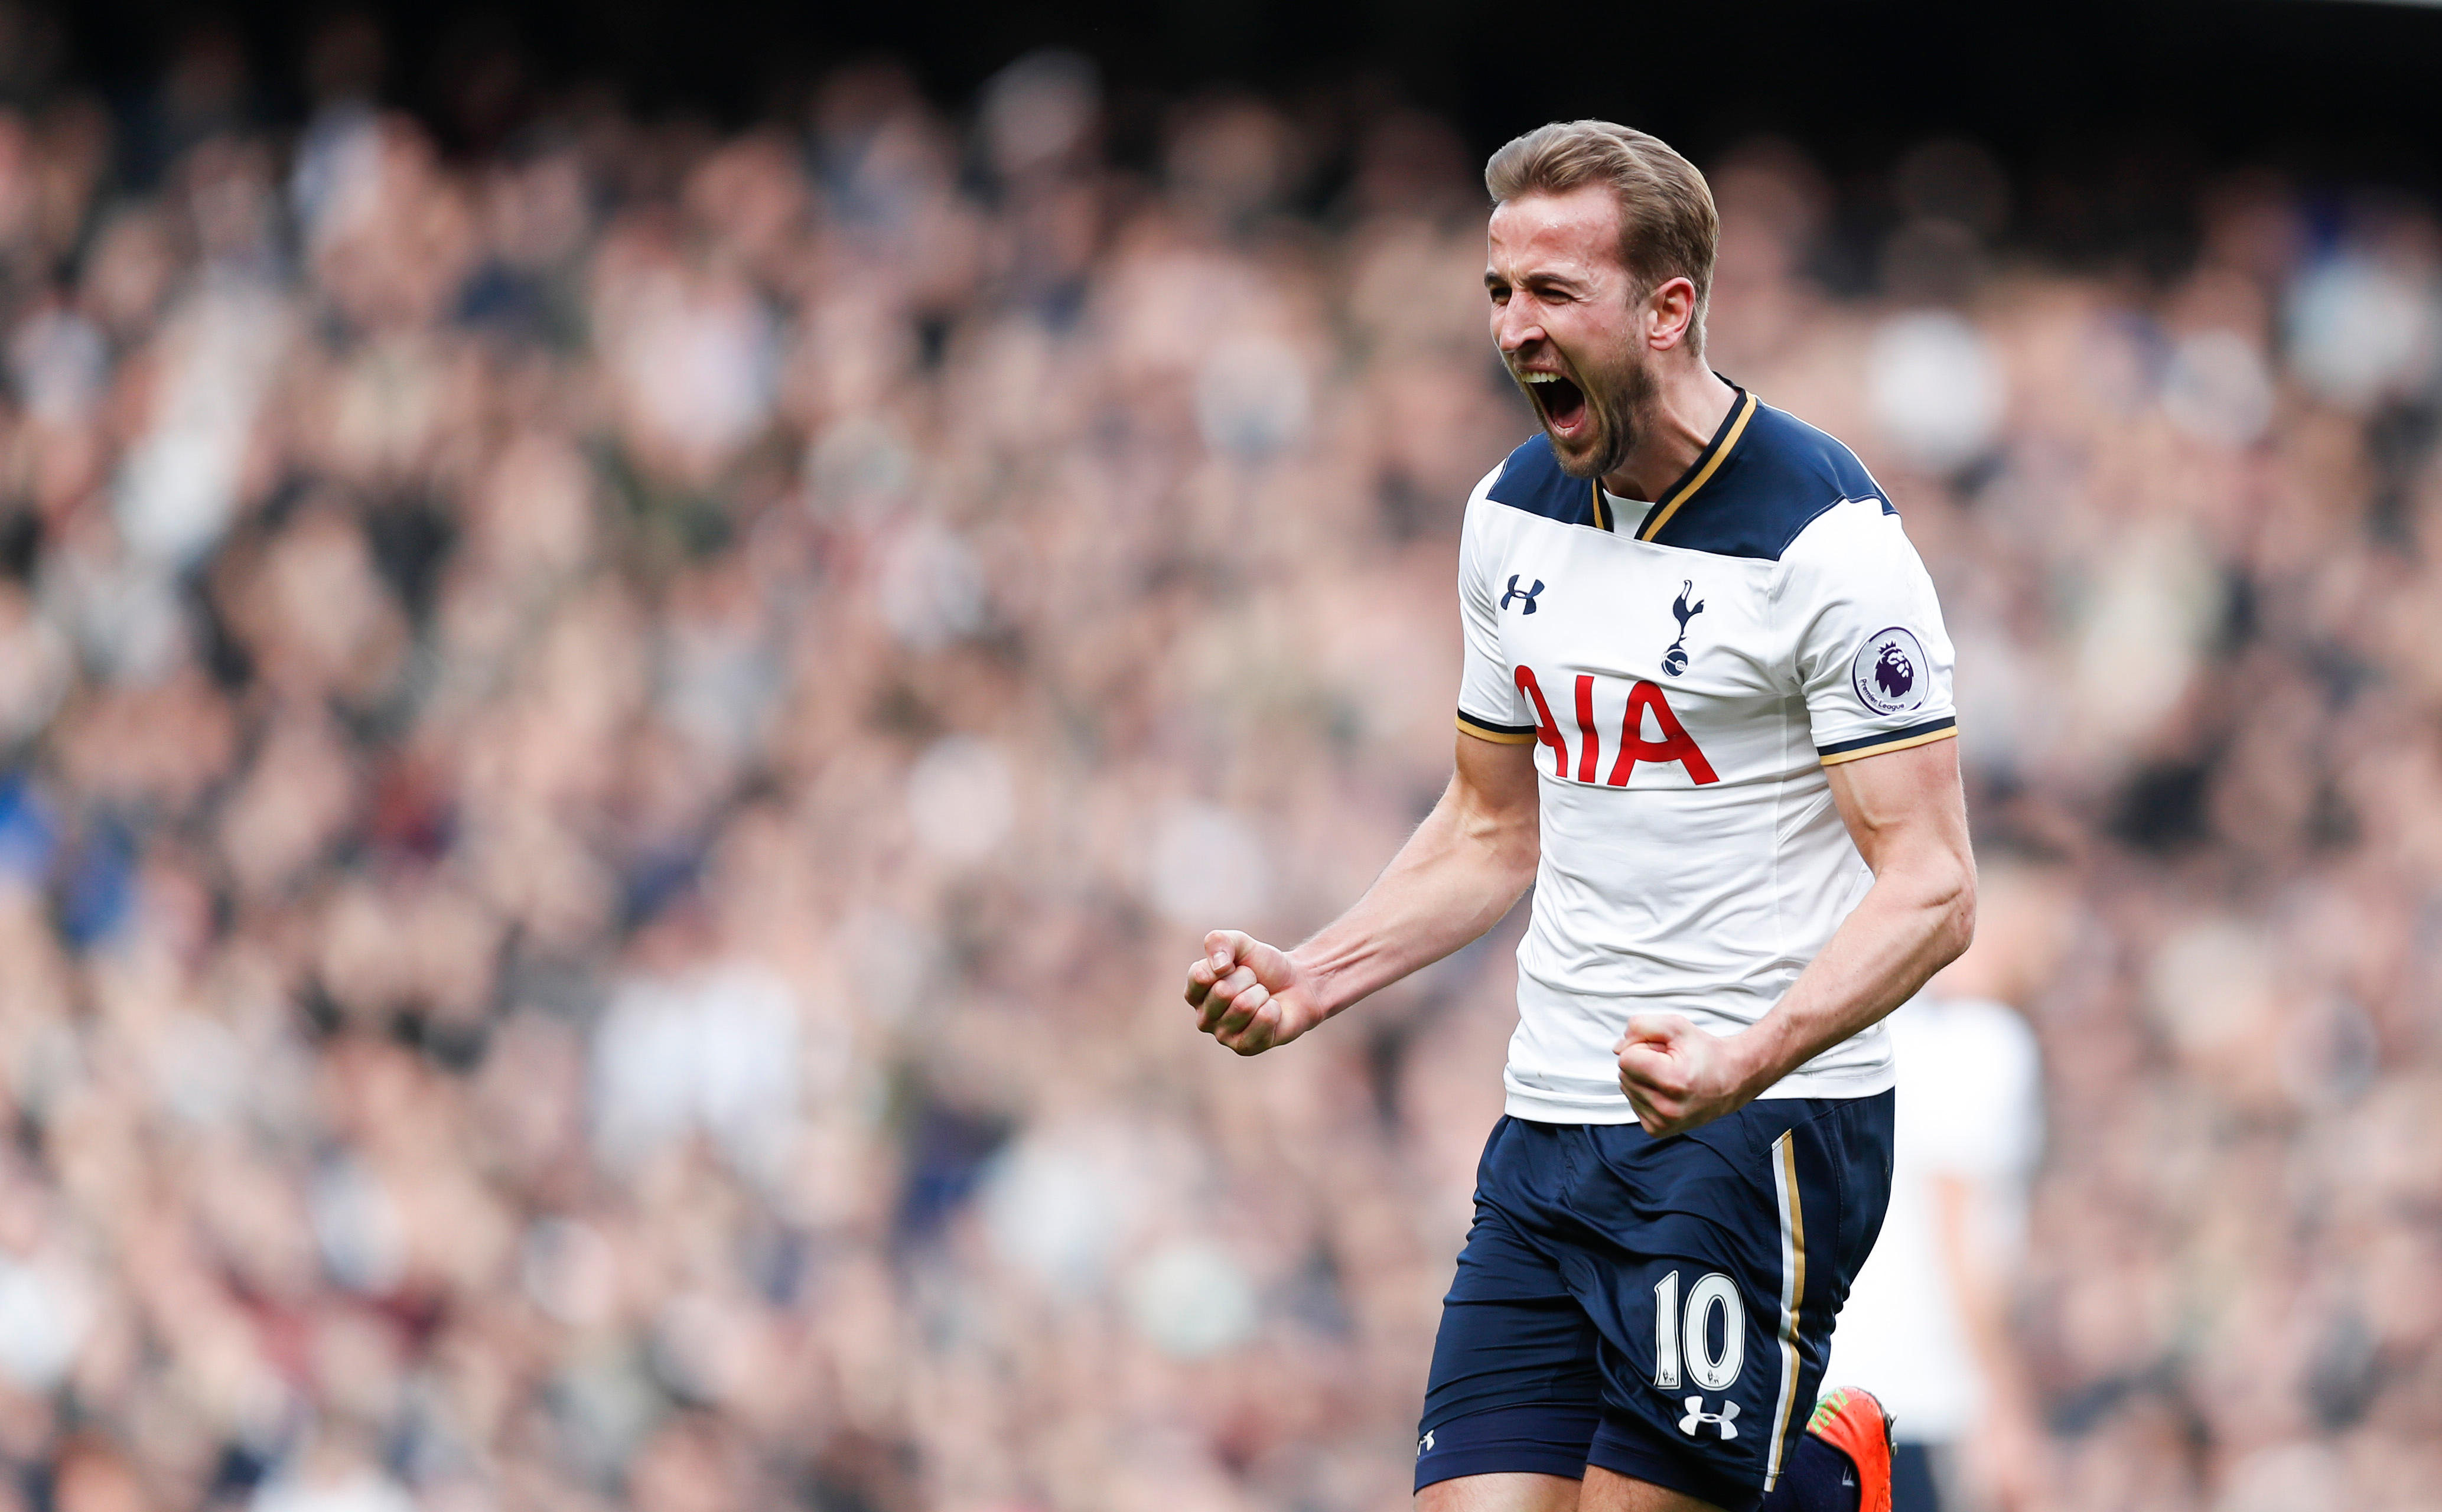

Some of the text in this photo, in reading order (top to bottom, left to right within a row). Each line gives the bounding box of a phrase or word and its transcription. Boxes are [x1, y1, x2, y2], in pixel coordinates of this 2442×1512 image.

[1515, 664, 1720, 787] AIA
[1860, 679, 1904, 711] Premier League
[1653, 1270, 1746, 1391] 10
